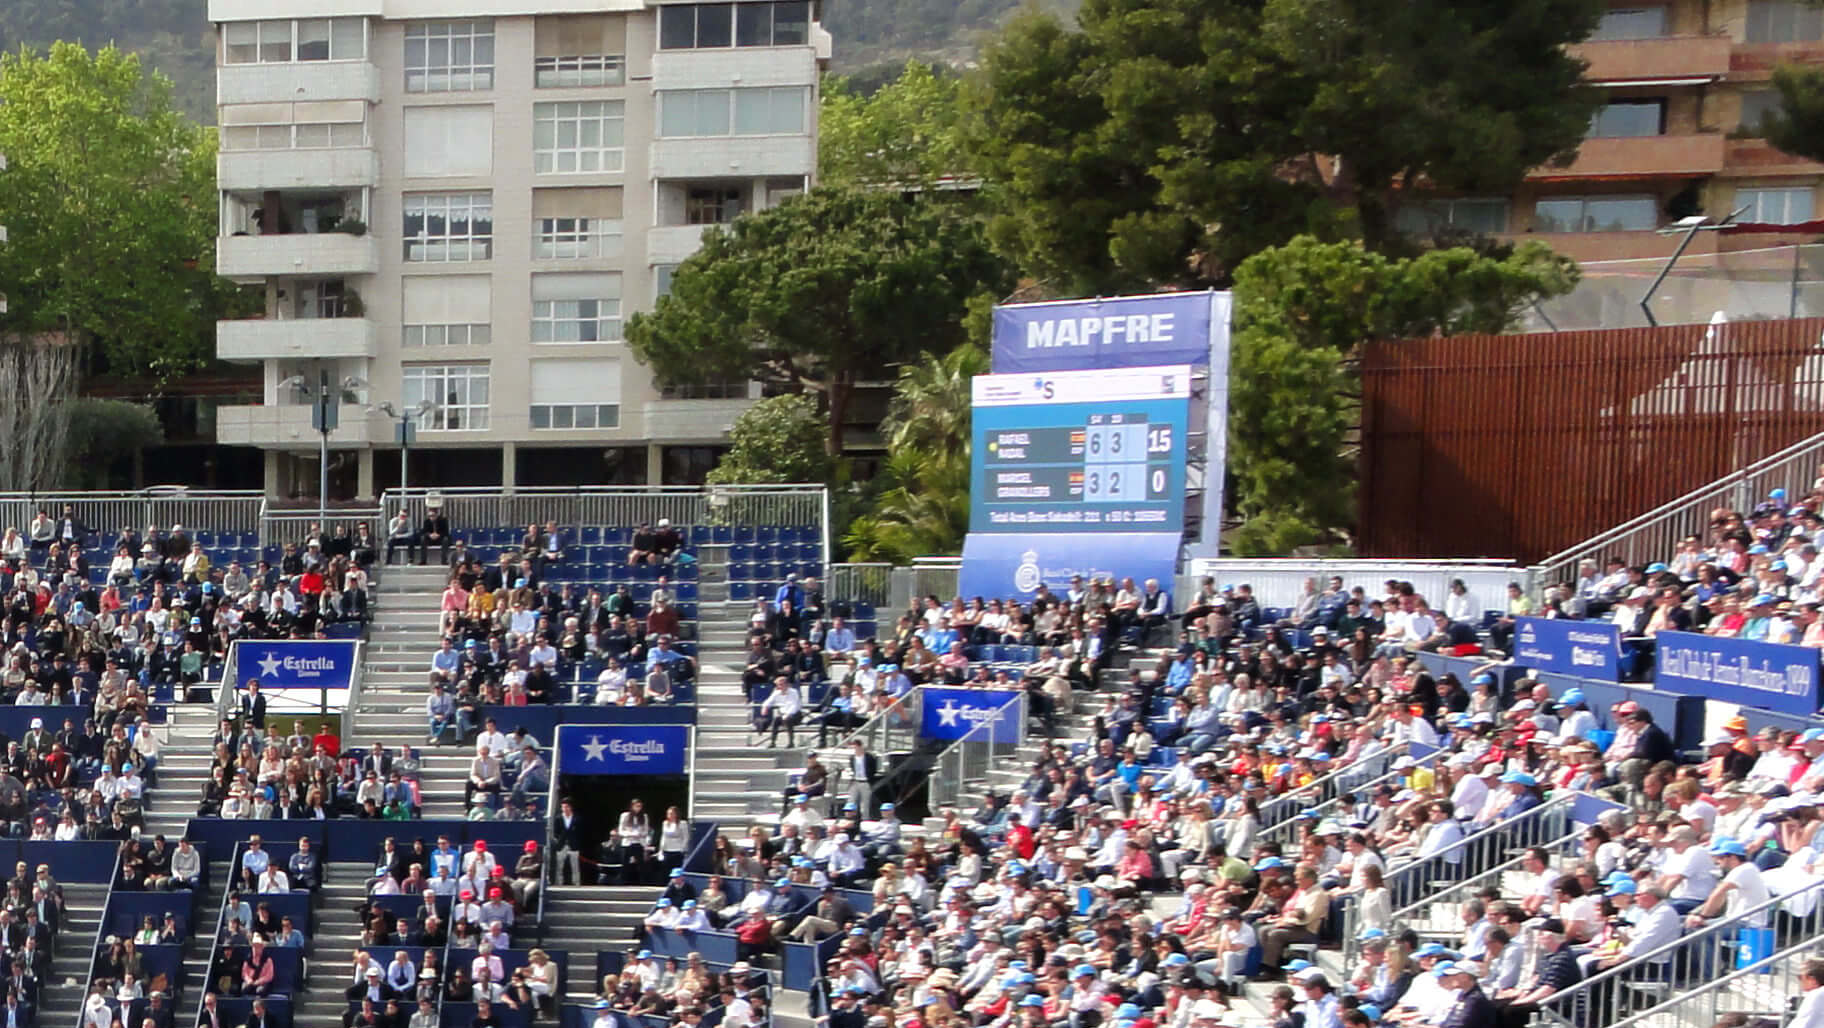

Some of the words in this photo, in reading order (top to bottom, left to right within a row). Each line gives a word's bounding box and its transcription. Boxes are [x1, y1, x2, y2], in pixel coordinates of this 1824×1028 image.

[1027, 313, 1175, 349] MAPFRE
[1090, 433, 1102, 454] 6
[1111, 432, 1122, 453] 3
[1148, 429, 1172, 452] 15
[1089, 473, 1101, 494] 3
[1109, 472, 1121, 493] 2
[1152, 470, 1165, 492] 0
[283, 656, 335, 671] Estrella
[608, 739, 665, 754] Estrella
